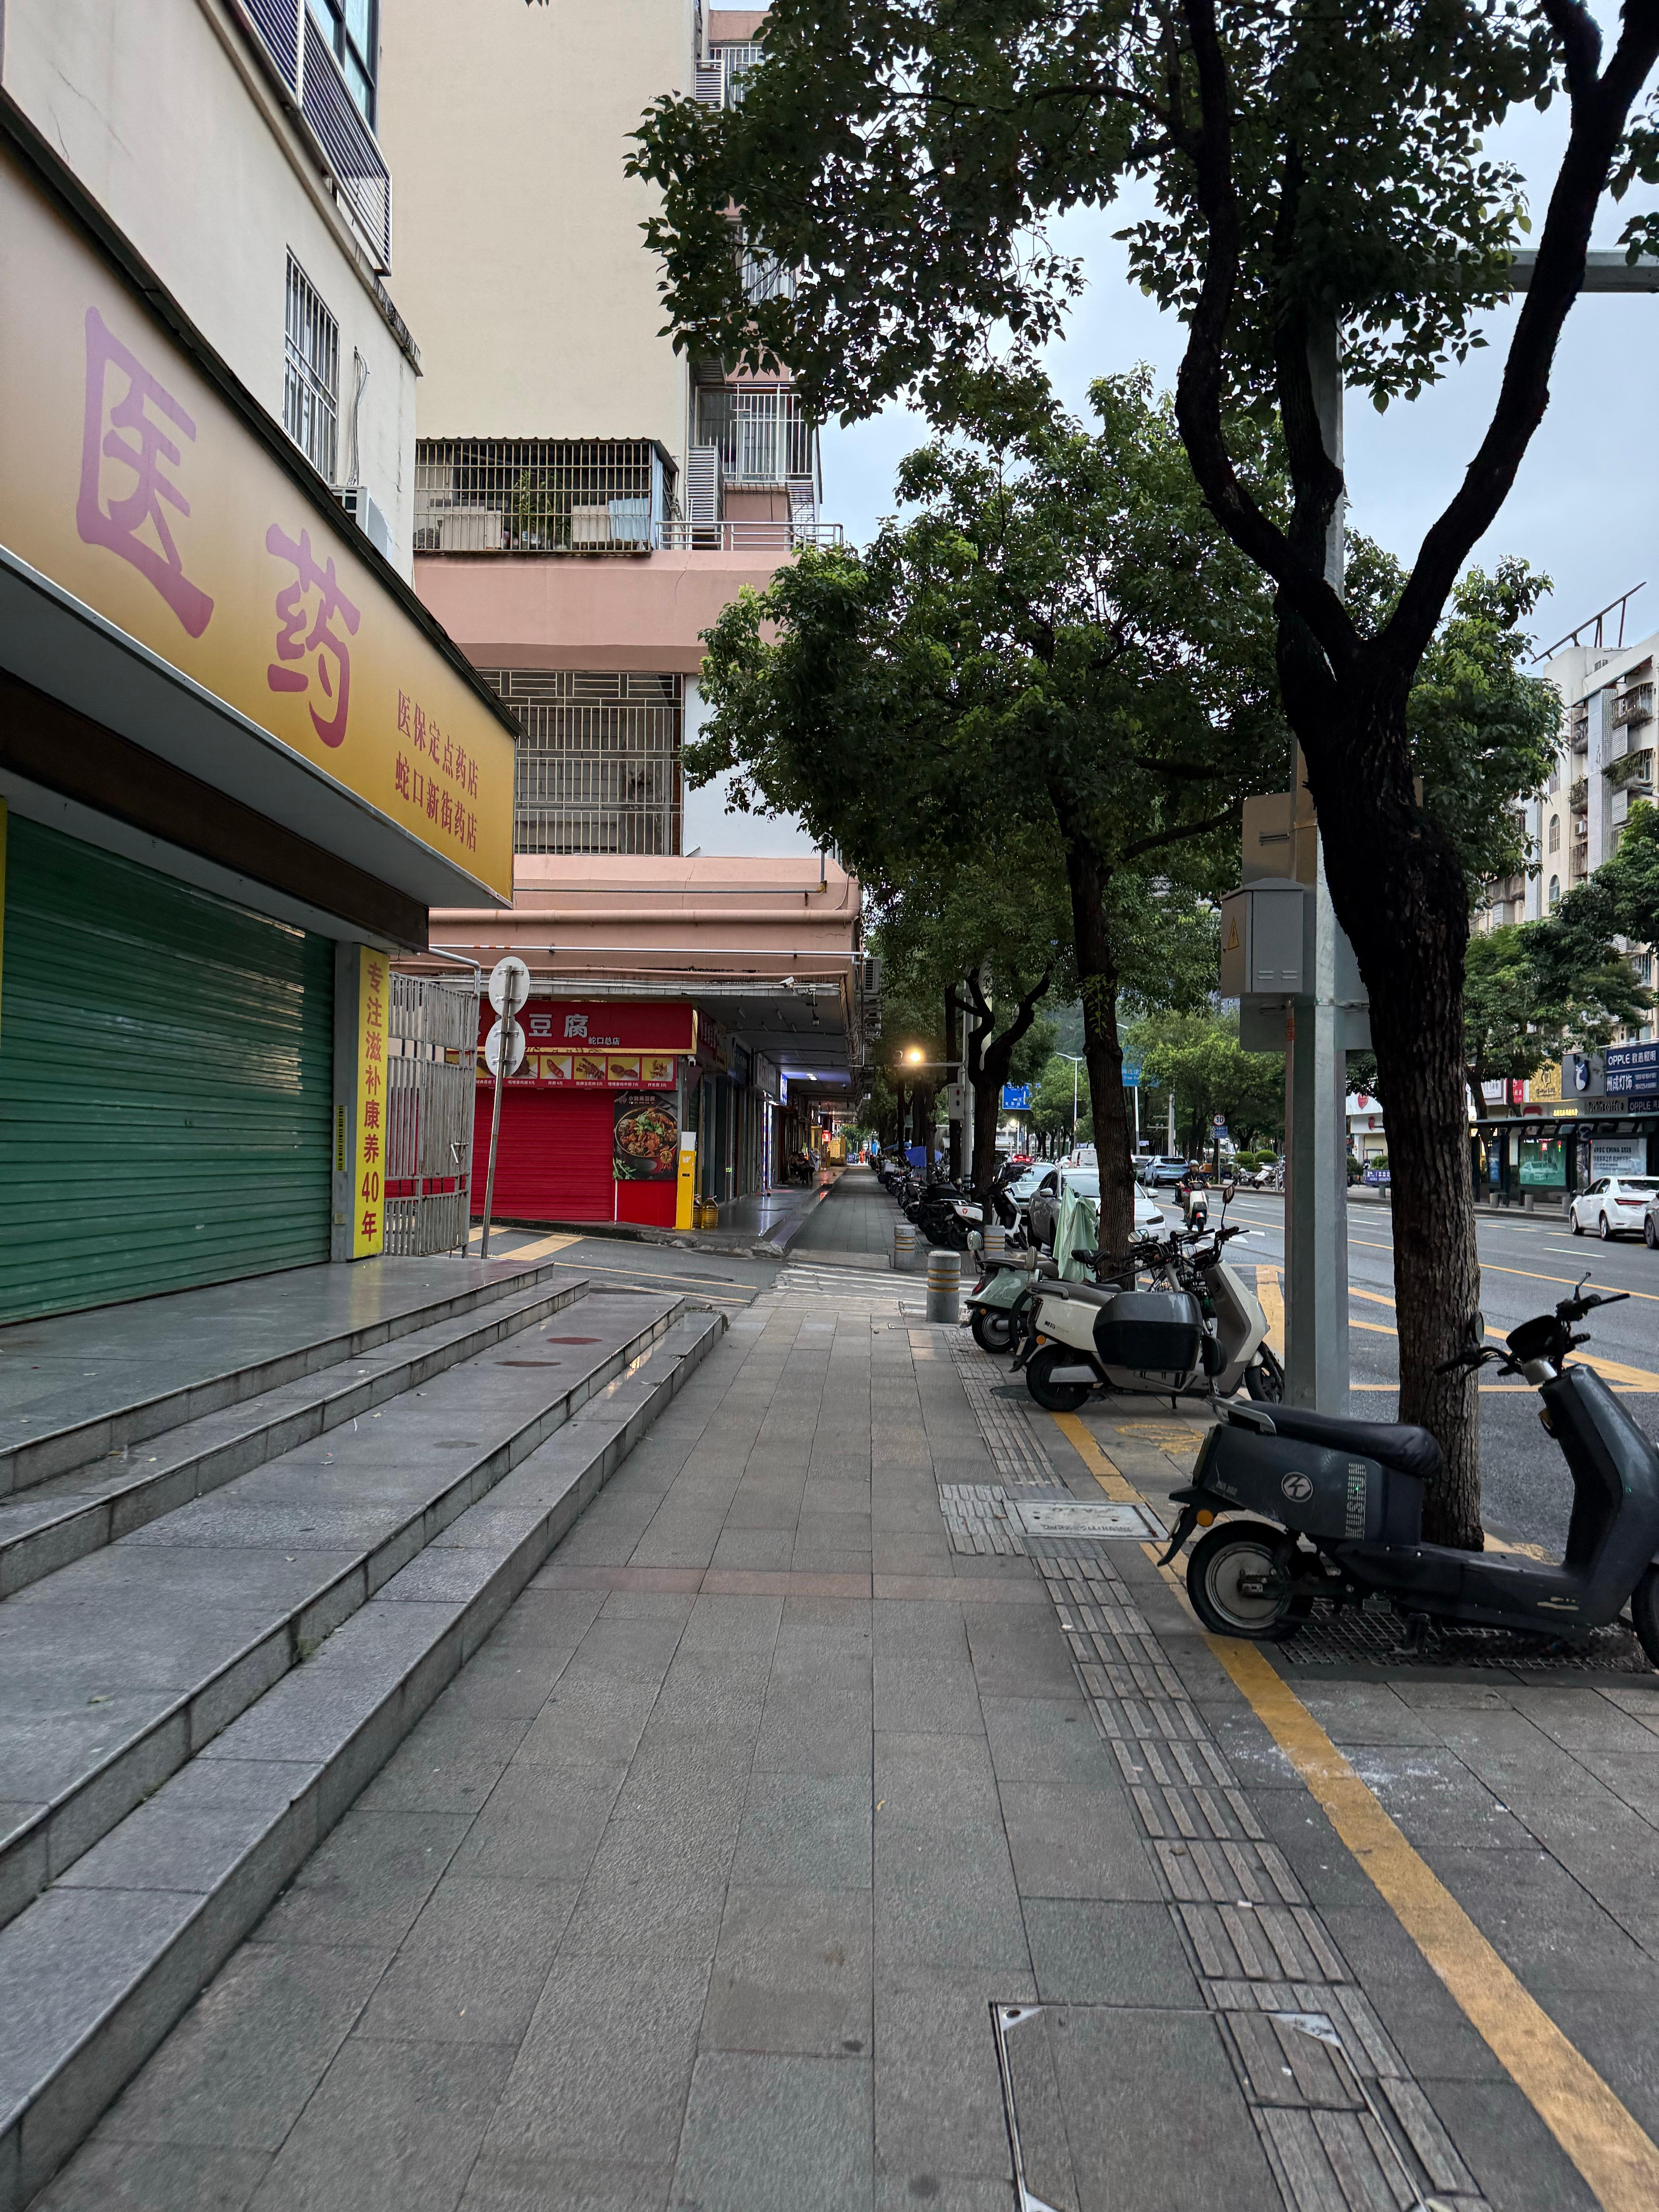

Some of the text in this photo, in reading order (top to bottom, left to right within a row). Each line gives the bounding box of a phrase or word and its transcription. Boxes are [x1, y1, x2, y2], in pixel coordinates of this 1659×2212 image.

[76, 306, 361, 748] 医药
[397, 689, 478, 799] 医保定点药店
[395, 750, 477, 852] 蛇口新街药店
[589, 1037, 620, 1045] 蛇口总店
[1608, 1054, 1630, 1065] OPPLE
[361, 962, 383, 1242] 专注滋补康养40年
[1630, 1101, 1650, 1113] OPPLE
